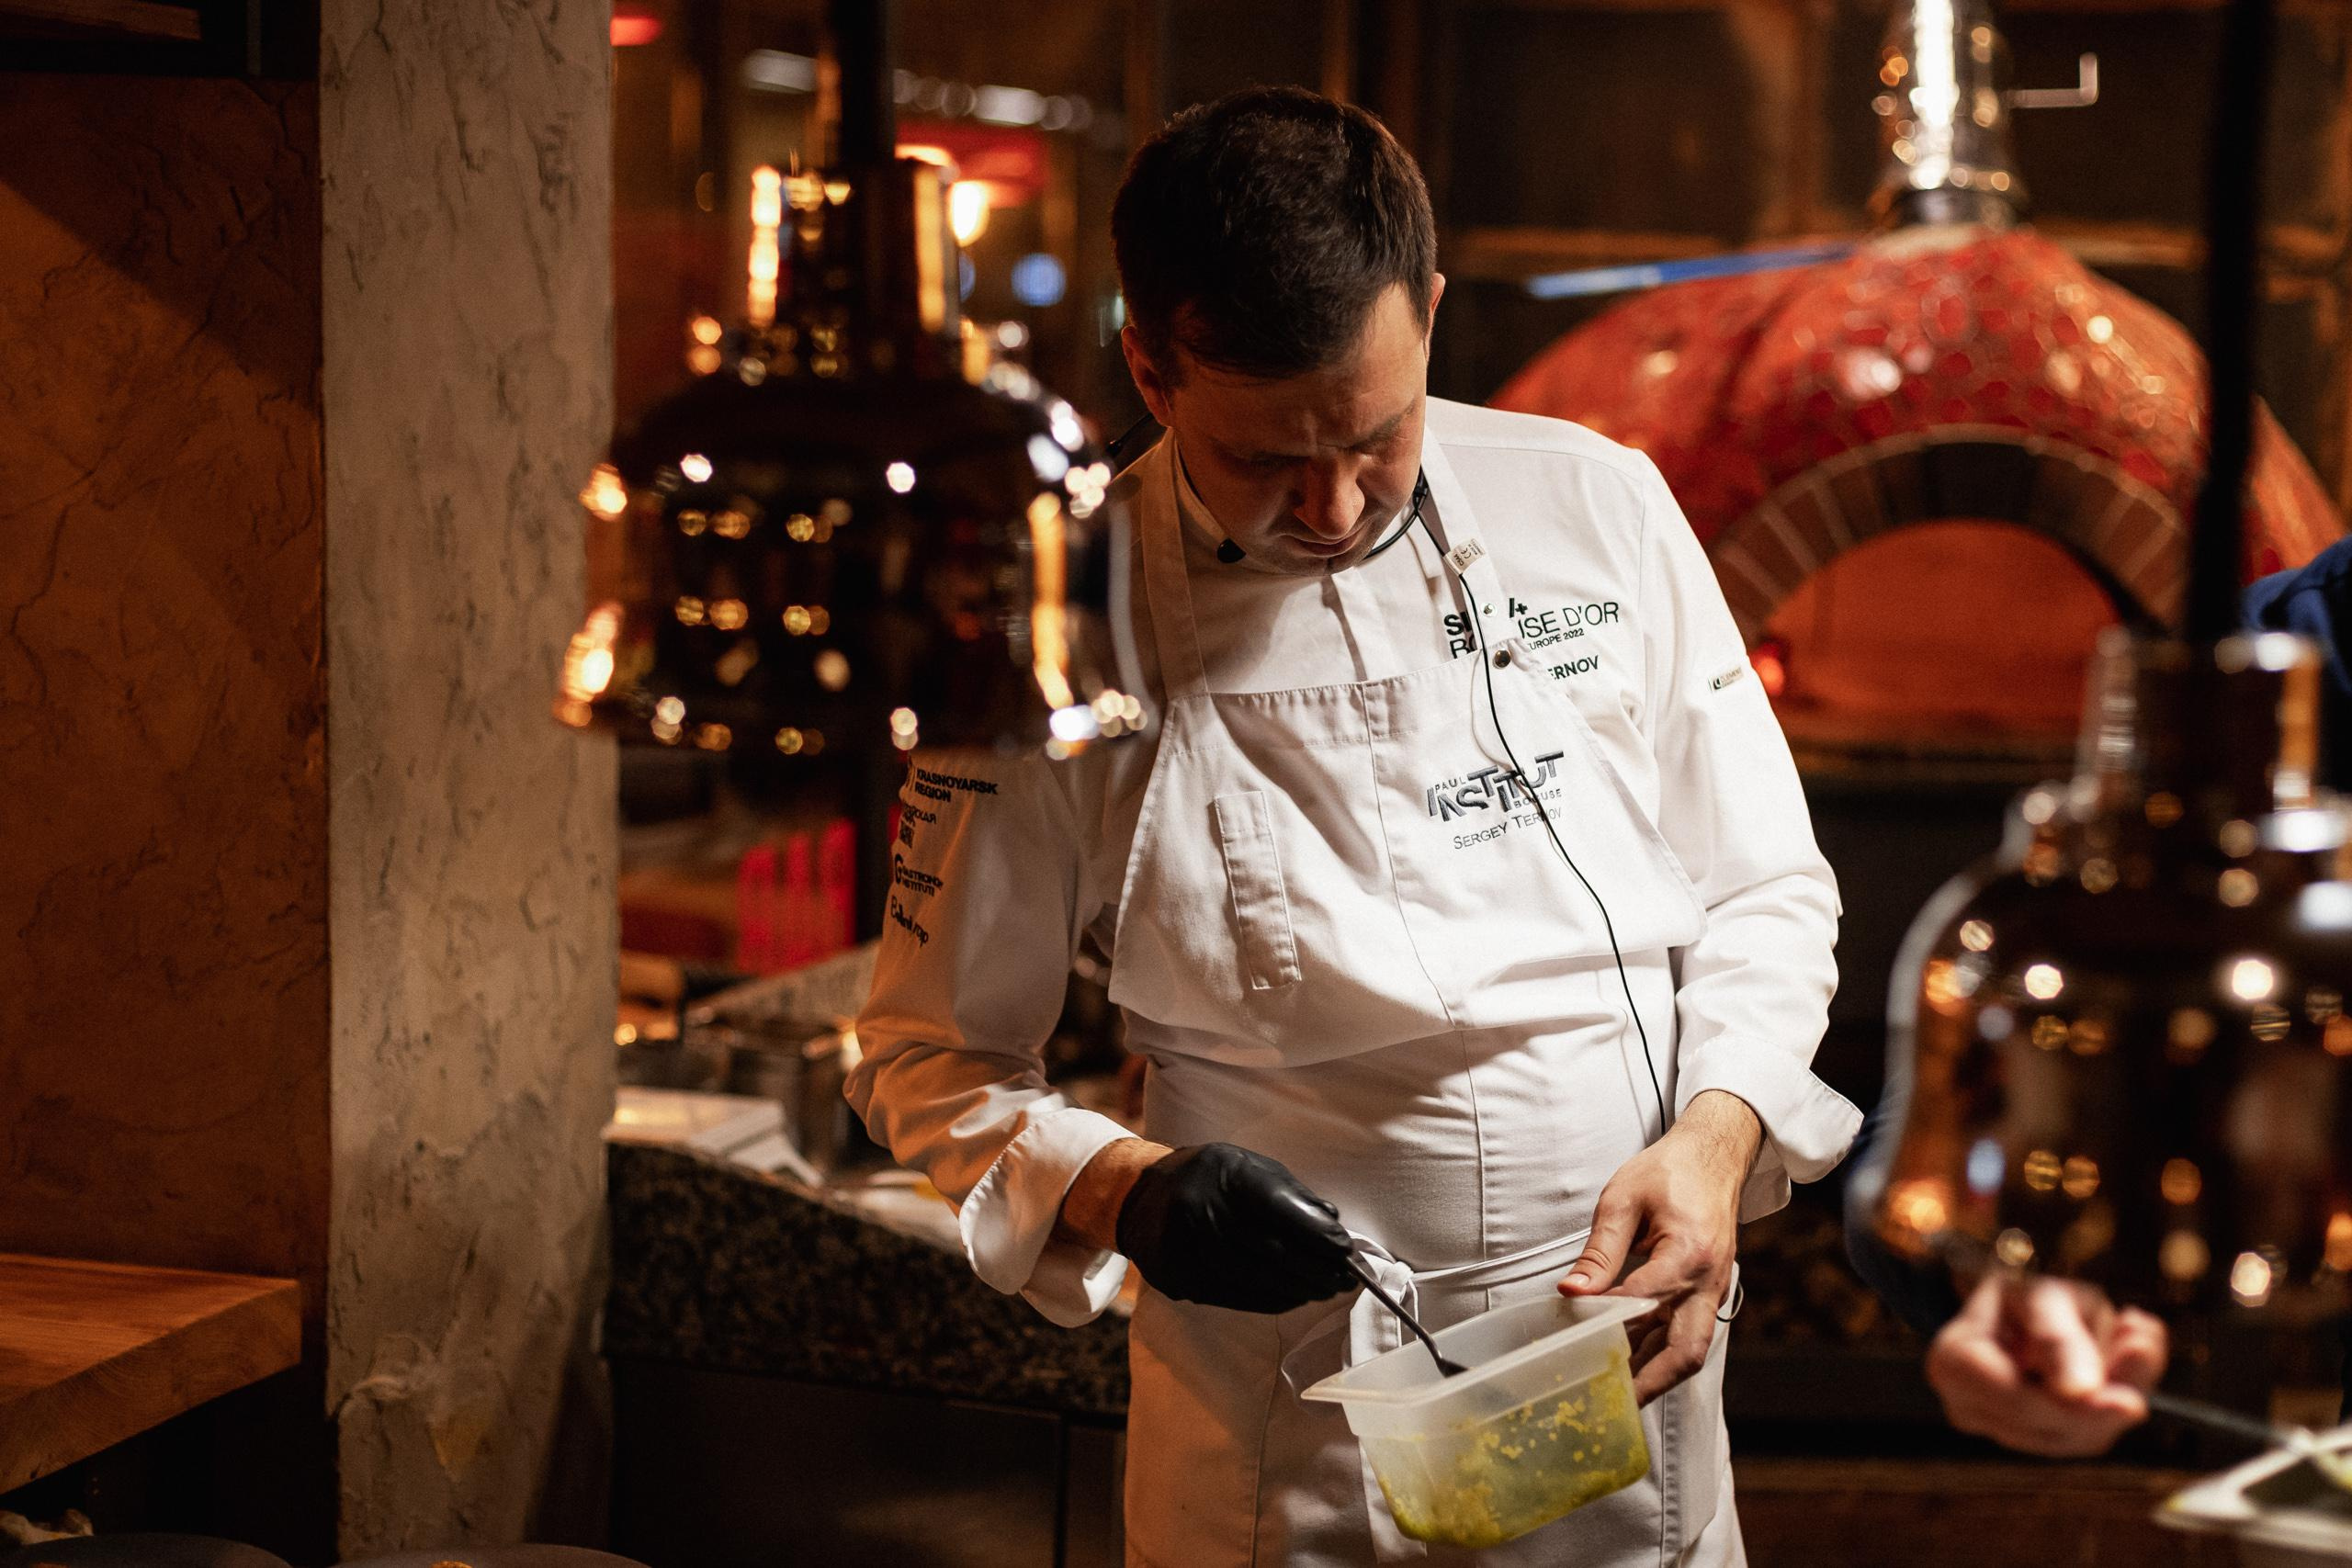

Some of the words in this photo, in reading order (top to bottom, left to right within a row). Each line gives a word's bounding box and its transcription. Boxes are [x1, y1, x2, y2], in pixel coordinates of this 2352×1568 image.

[1562, 602, 1619, 626] D'OR
[1528, 633, 1563, 650] UROPE
[1563, 627, 1585, 640] 2022
[1547, 655, 1599, 680] RNOV
[915, 781, 951, 802] REGION
[916, 768, 999, 795] KRASNOYARSK
[1434, 776, 1467, 794] PAUL
[1513, 788, 1562, 809] BOUSE
[1510, 807, 1561, 829] TEROV
